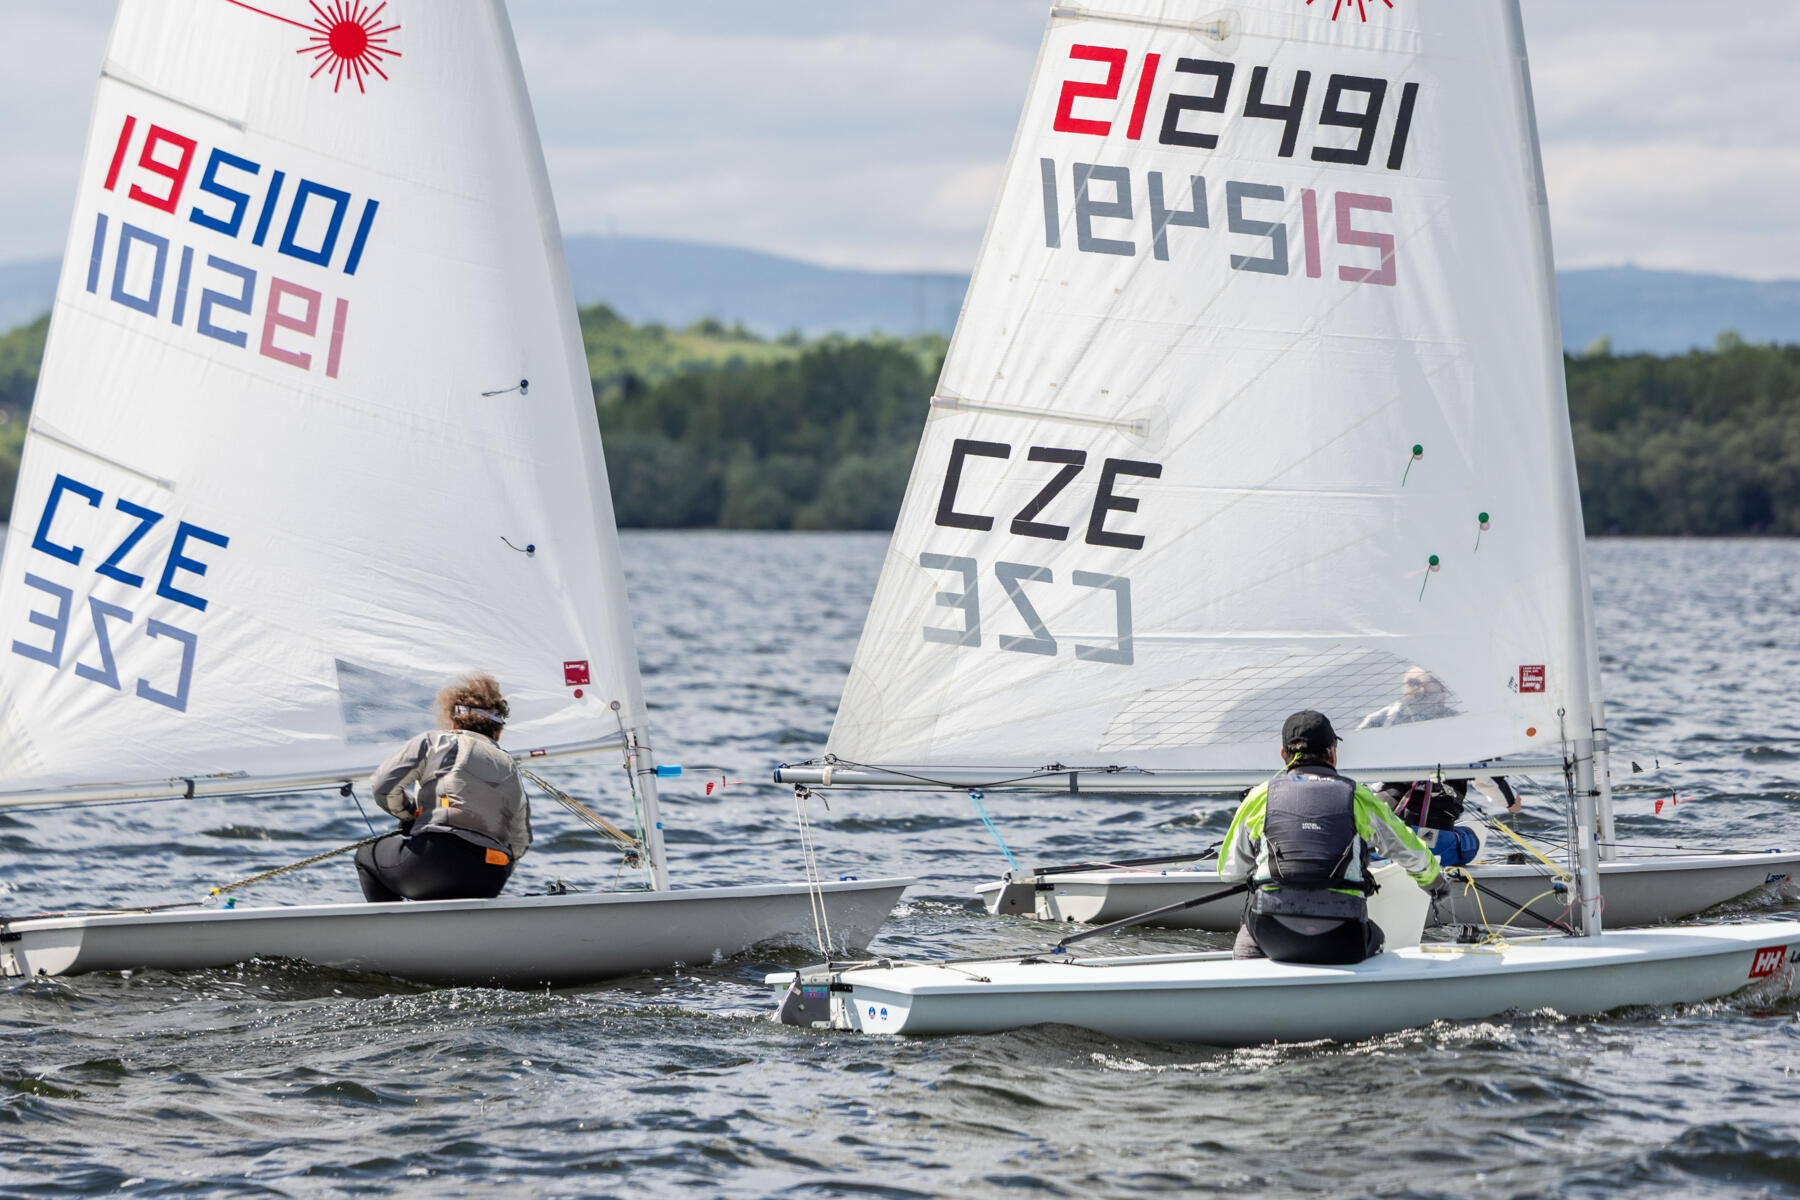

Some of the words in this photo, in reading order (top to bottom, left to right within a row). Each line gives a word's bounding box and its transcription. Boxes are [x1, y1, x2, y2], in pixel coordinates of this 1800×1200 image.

[1053, 44, 1420, 170] 212491
[104, 114, 380, 276] 195101
[31, 473, 231, 612] CZE
[935, 438, 1163, 550] CZE
